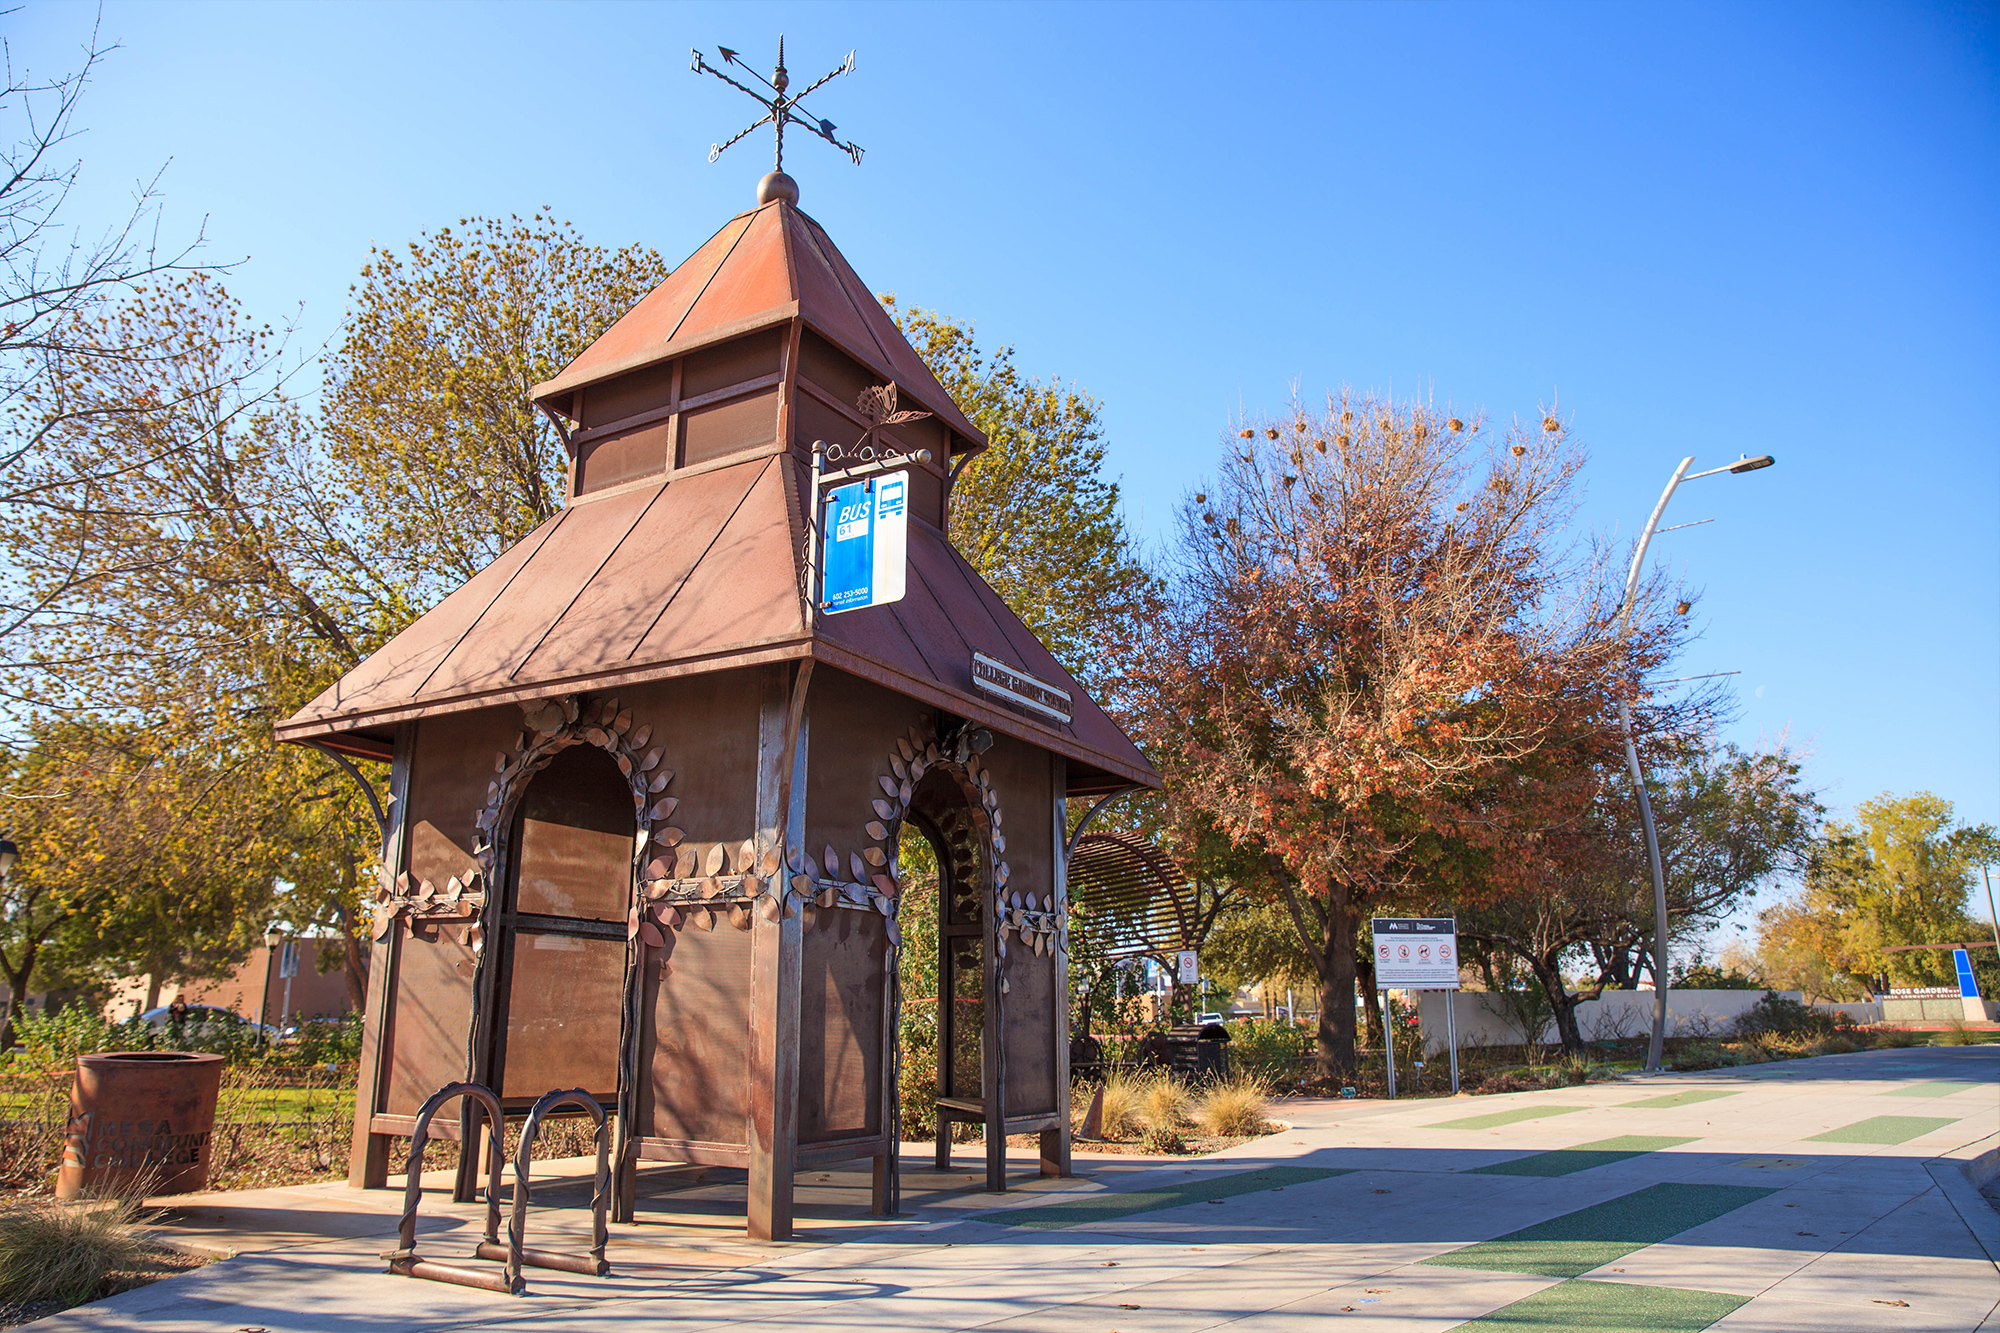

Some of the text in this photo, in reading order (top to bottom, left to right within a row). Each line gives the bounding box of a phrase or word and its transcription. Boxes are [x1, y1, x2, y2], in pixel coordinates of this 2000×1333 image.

[846, 140, 866, 167] W
[838, 501, 871, 523] BUS
[839, 524, 851, 535] 61
[843, 587, 868, 598] 253-5000
[98, 1119, 172, 1136] MESA
[96, 1131, 210, 1153] COMMUNIT
[94, 1148, 199, 1169] COLLEGE
